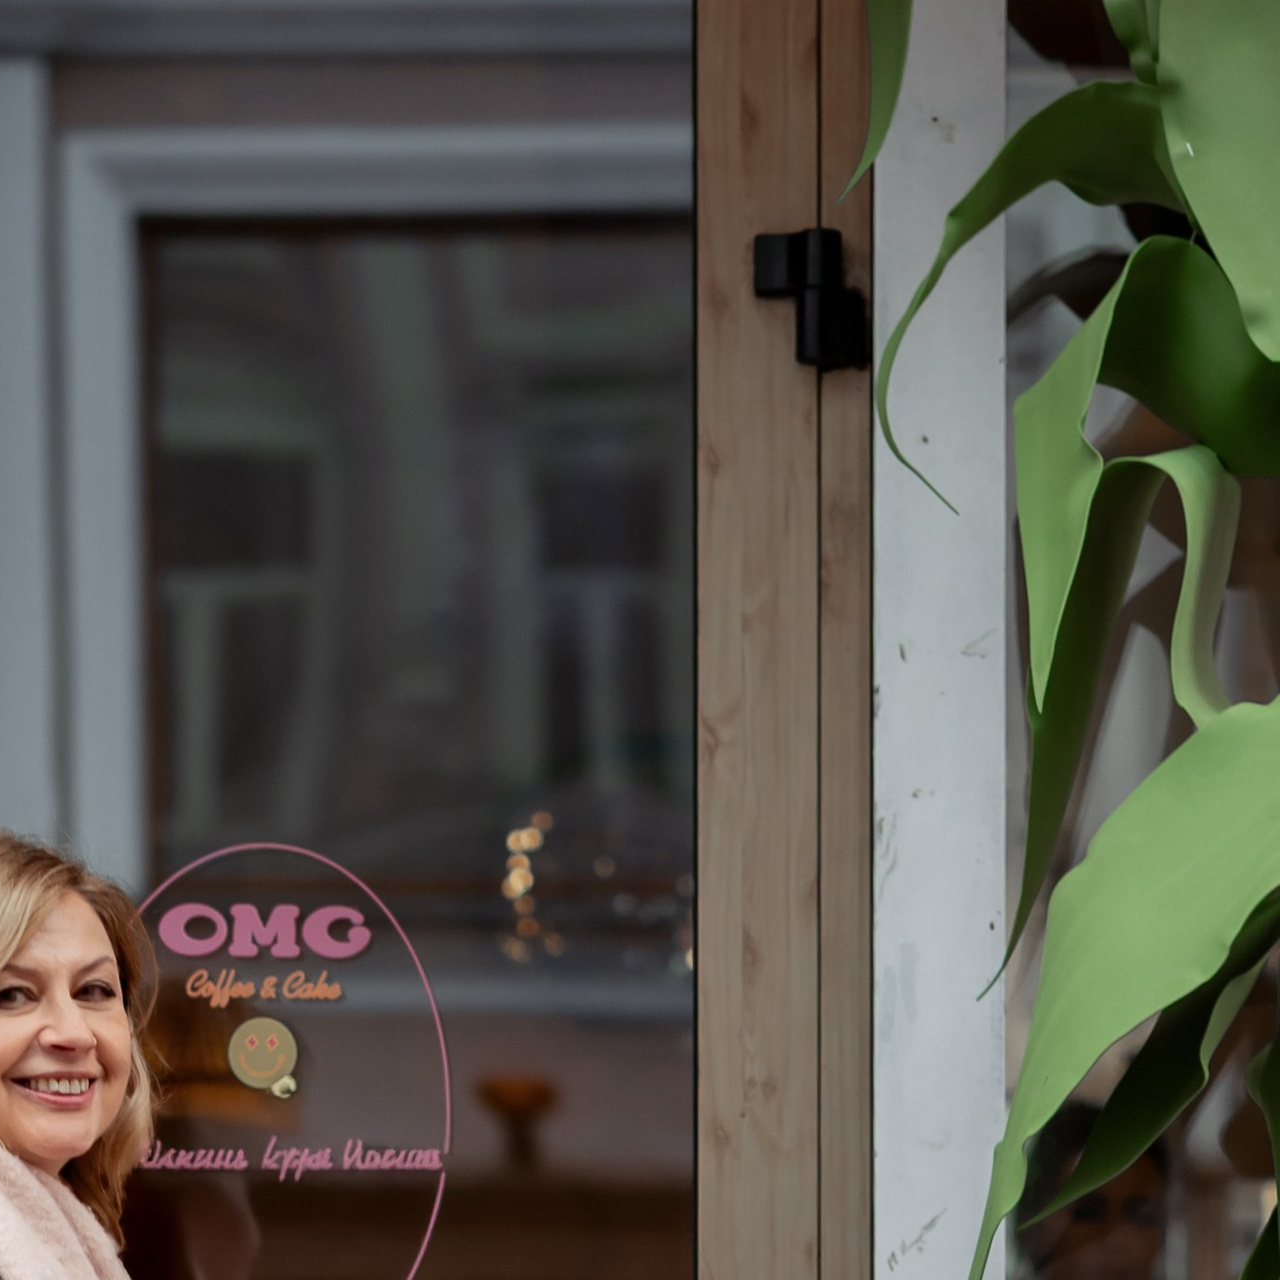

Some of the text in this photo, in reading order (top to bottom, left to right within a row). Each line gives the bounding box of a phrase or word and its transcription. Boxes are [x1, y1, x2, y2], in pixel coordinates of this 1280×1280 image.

[158, 903, 372, 959] OMG
[186, 968, 342, 1008] Coffee & Cake
